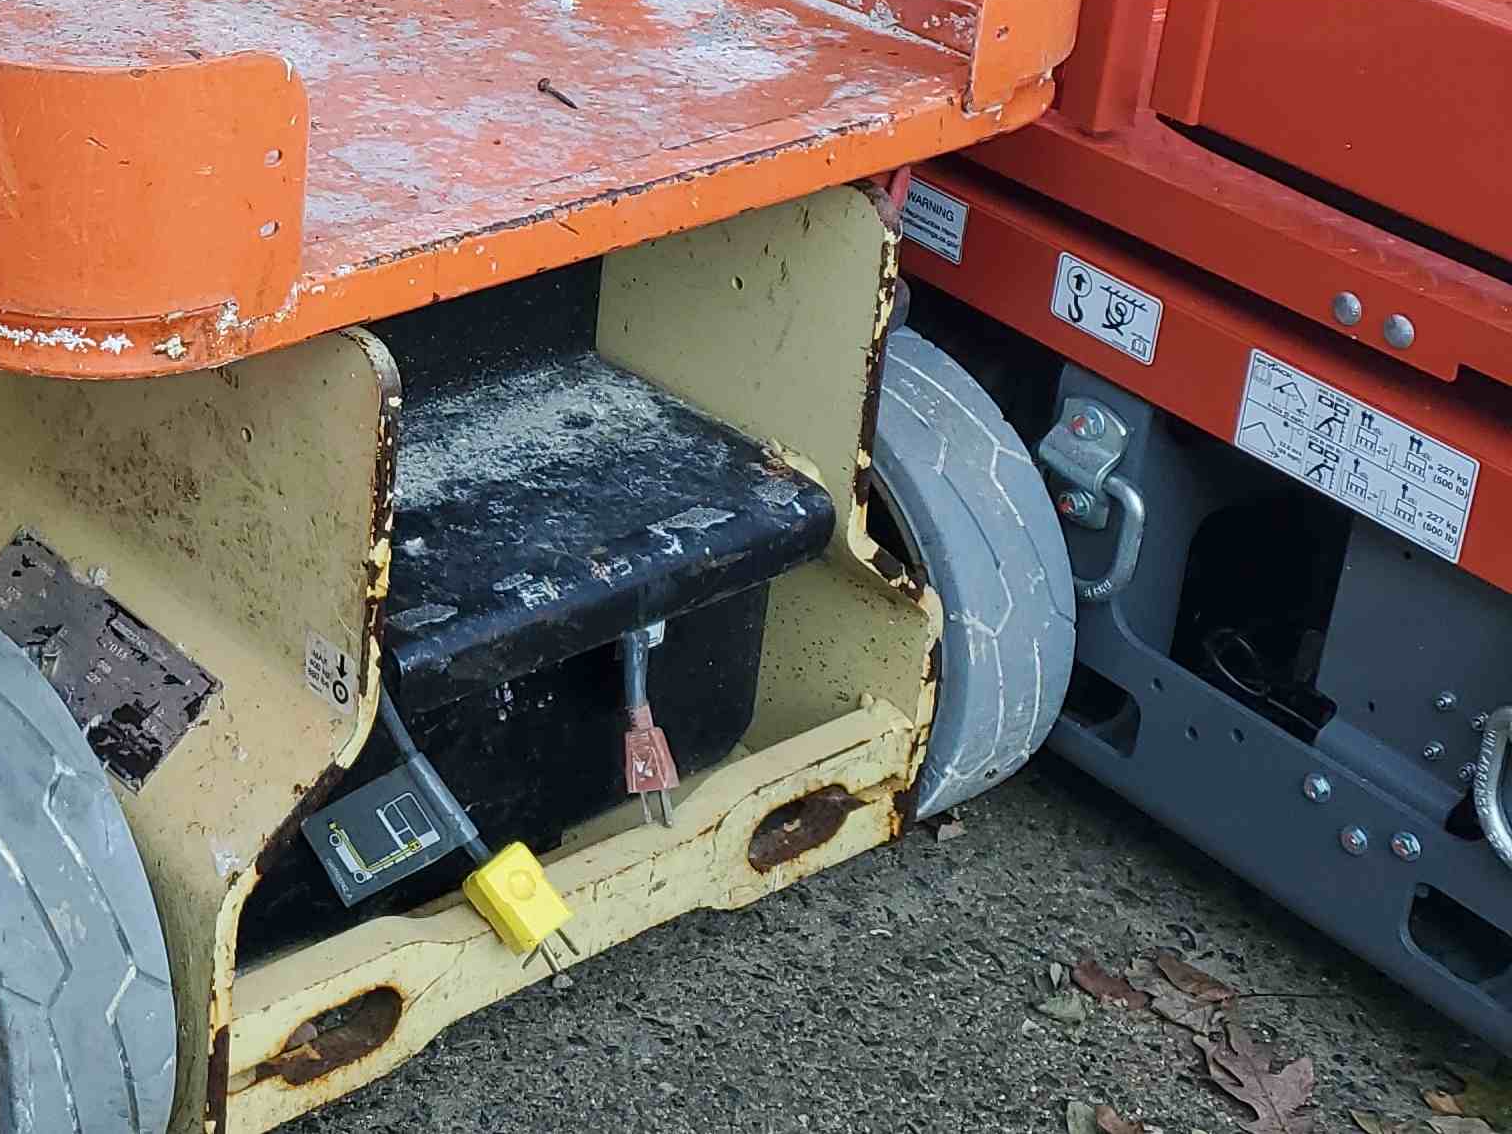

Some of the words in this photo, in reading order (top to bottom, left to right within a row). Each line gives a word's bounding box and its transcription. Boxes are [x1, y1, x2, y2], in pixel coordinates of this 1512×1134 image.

[908, 191, 954, 223] WARNING
[1437, 463, 1454, 477] 227
[1456, 473, 1468, 486] kg
[1426, 511, 1444, 524] 227
[1446, 521, 1458, 534] kg
